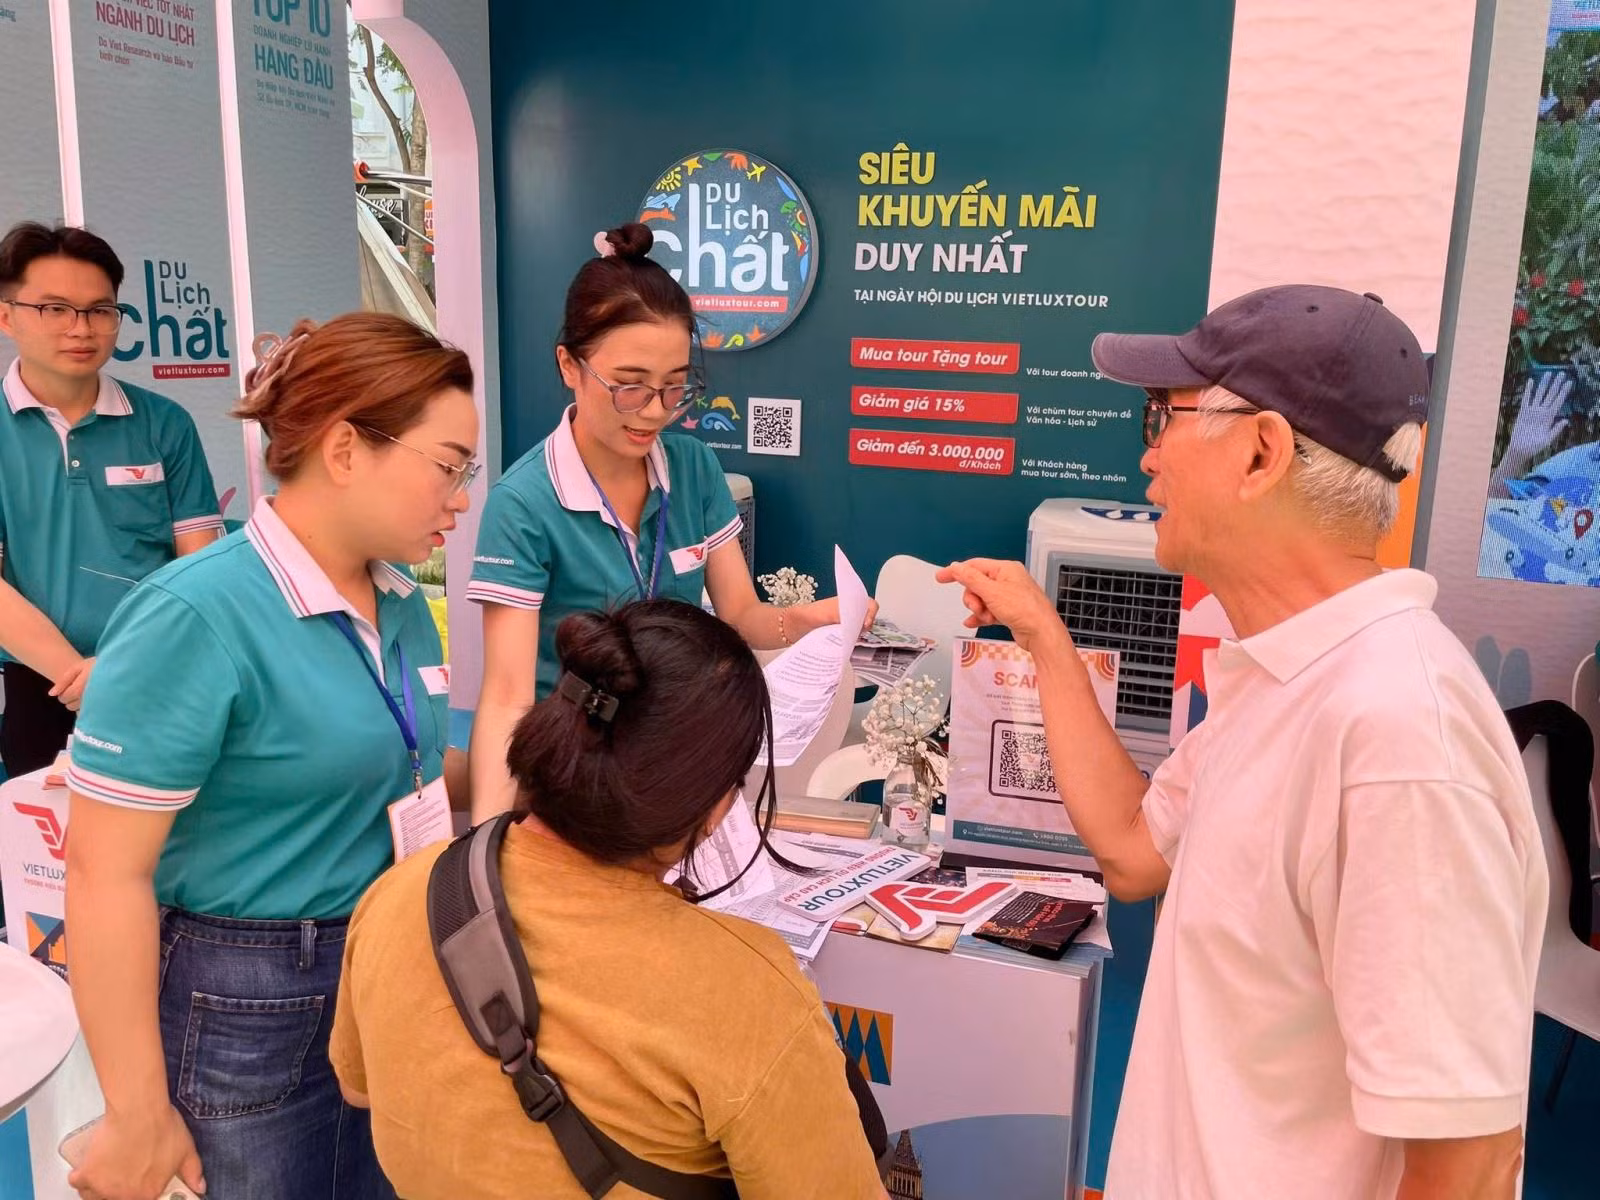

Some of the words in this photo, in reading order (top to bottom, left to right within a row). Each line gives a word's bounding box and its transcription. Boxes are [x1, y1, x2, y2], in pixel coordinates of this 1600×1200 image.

[96, 1, 143, 33] NGÀNH
[146, 14, 164, 38] DU
[168, 20, 195, 47] LỊCH
[308, 0, 331, 37] 10
[858, 142, 936, 185] SIÊU
[705, 182, 741, 203] DU
[857, 179, 1007, 227] KHUYẾN
[1018, 185, 1097, 228] MÃI
[705, 204, 769, 236] Lịch
[854, 242, 924, 272] DUY
[932, 229, 1028, 273] NHẤT
[159, 260, 187, 280] DU
[160, 280, 211, 310] Lịch
[854, 289, 874, 305] TẠI
[876, 287, 914, 303] NGÀY
[917, 288, 942, 306] HỘI
[944, 291, 963, 304] DU
[967, 291, 998, 308] LỊCH
[1002, 293, 1109, 308] VIETLUXTOUR
[859, 346, 893, 361] Mua
[896, 348, 929, 363] tour
[931, 348, 971, 368] Tặng
[974, 351, 1008, 366] tour
[158, 366, 225, 375] vietluxtour.com
[1042, 368, 1059, 377] tour
[1060, 369, 1088, 378] doanh
[859, 392, 900, 409] Giảm
[903, 395, 930, 413] giá
[934, 397, 966, 412] 15%
[1068, 407, 1085, 416] tour
[1086, 409, 1118, 419] chuyên
[1045, 416, 1061, 425] hóa
[1067, 418, 1085, 427] Lịch
[856, 437, 895, 452] Giảm
[897, 438, 926, 456] đến
[928, 443, 1005, 461] 3.000.000
[1021, 469, 1040, 477] mua
[1041, 470, 1058, 478] tour
[1081, 472, 1101, 480] theo
[1102, 473, 1127, 482] nhóm
[1037, 459, 1064, 469] Khách
[1066, 460, 1088, 472] hàng
[798, 853, 920, 912] VIETLUXTOUR
